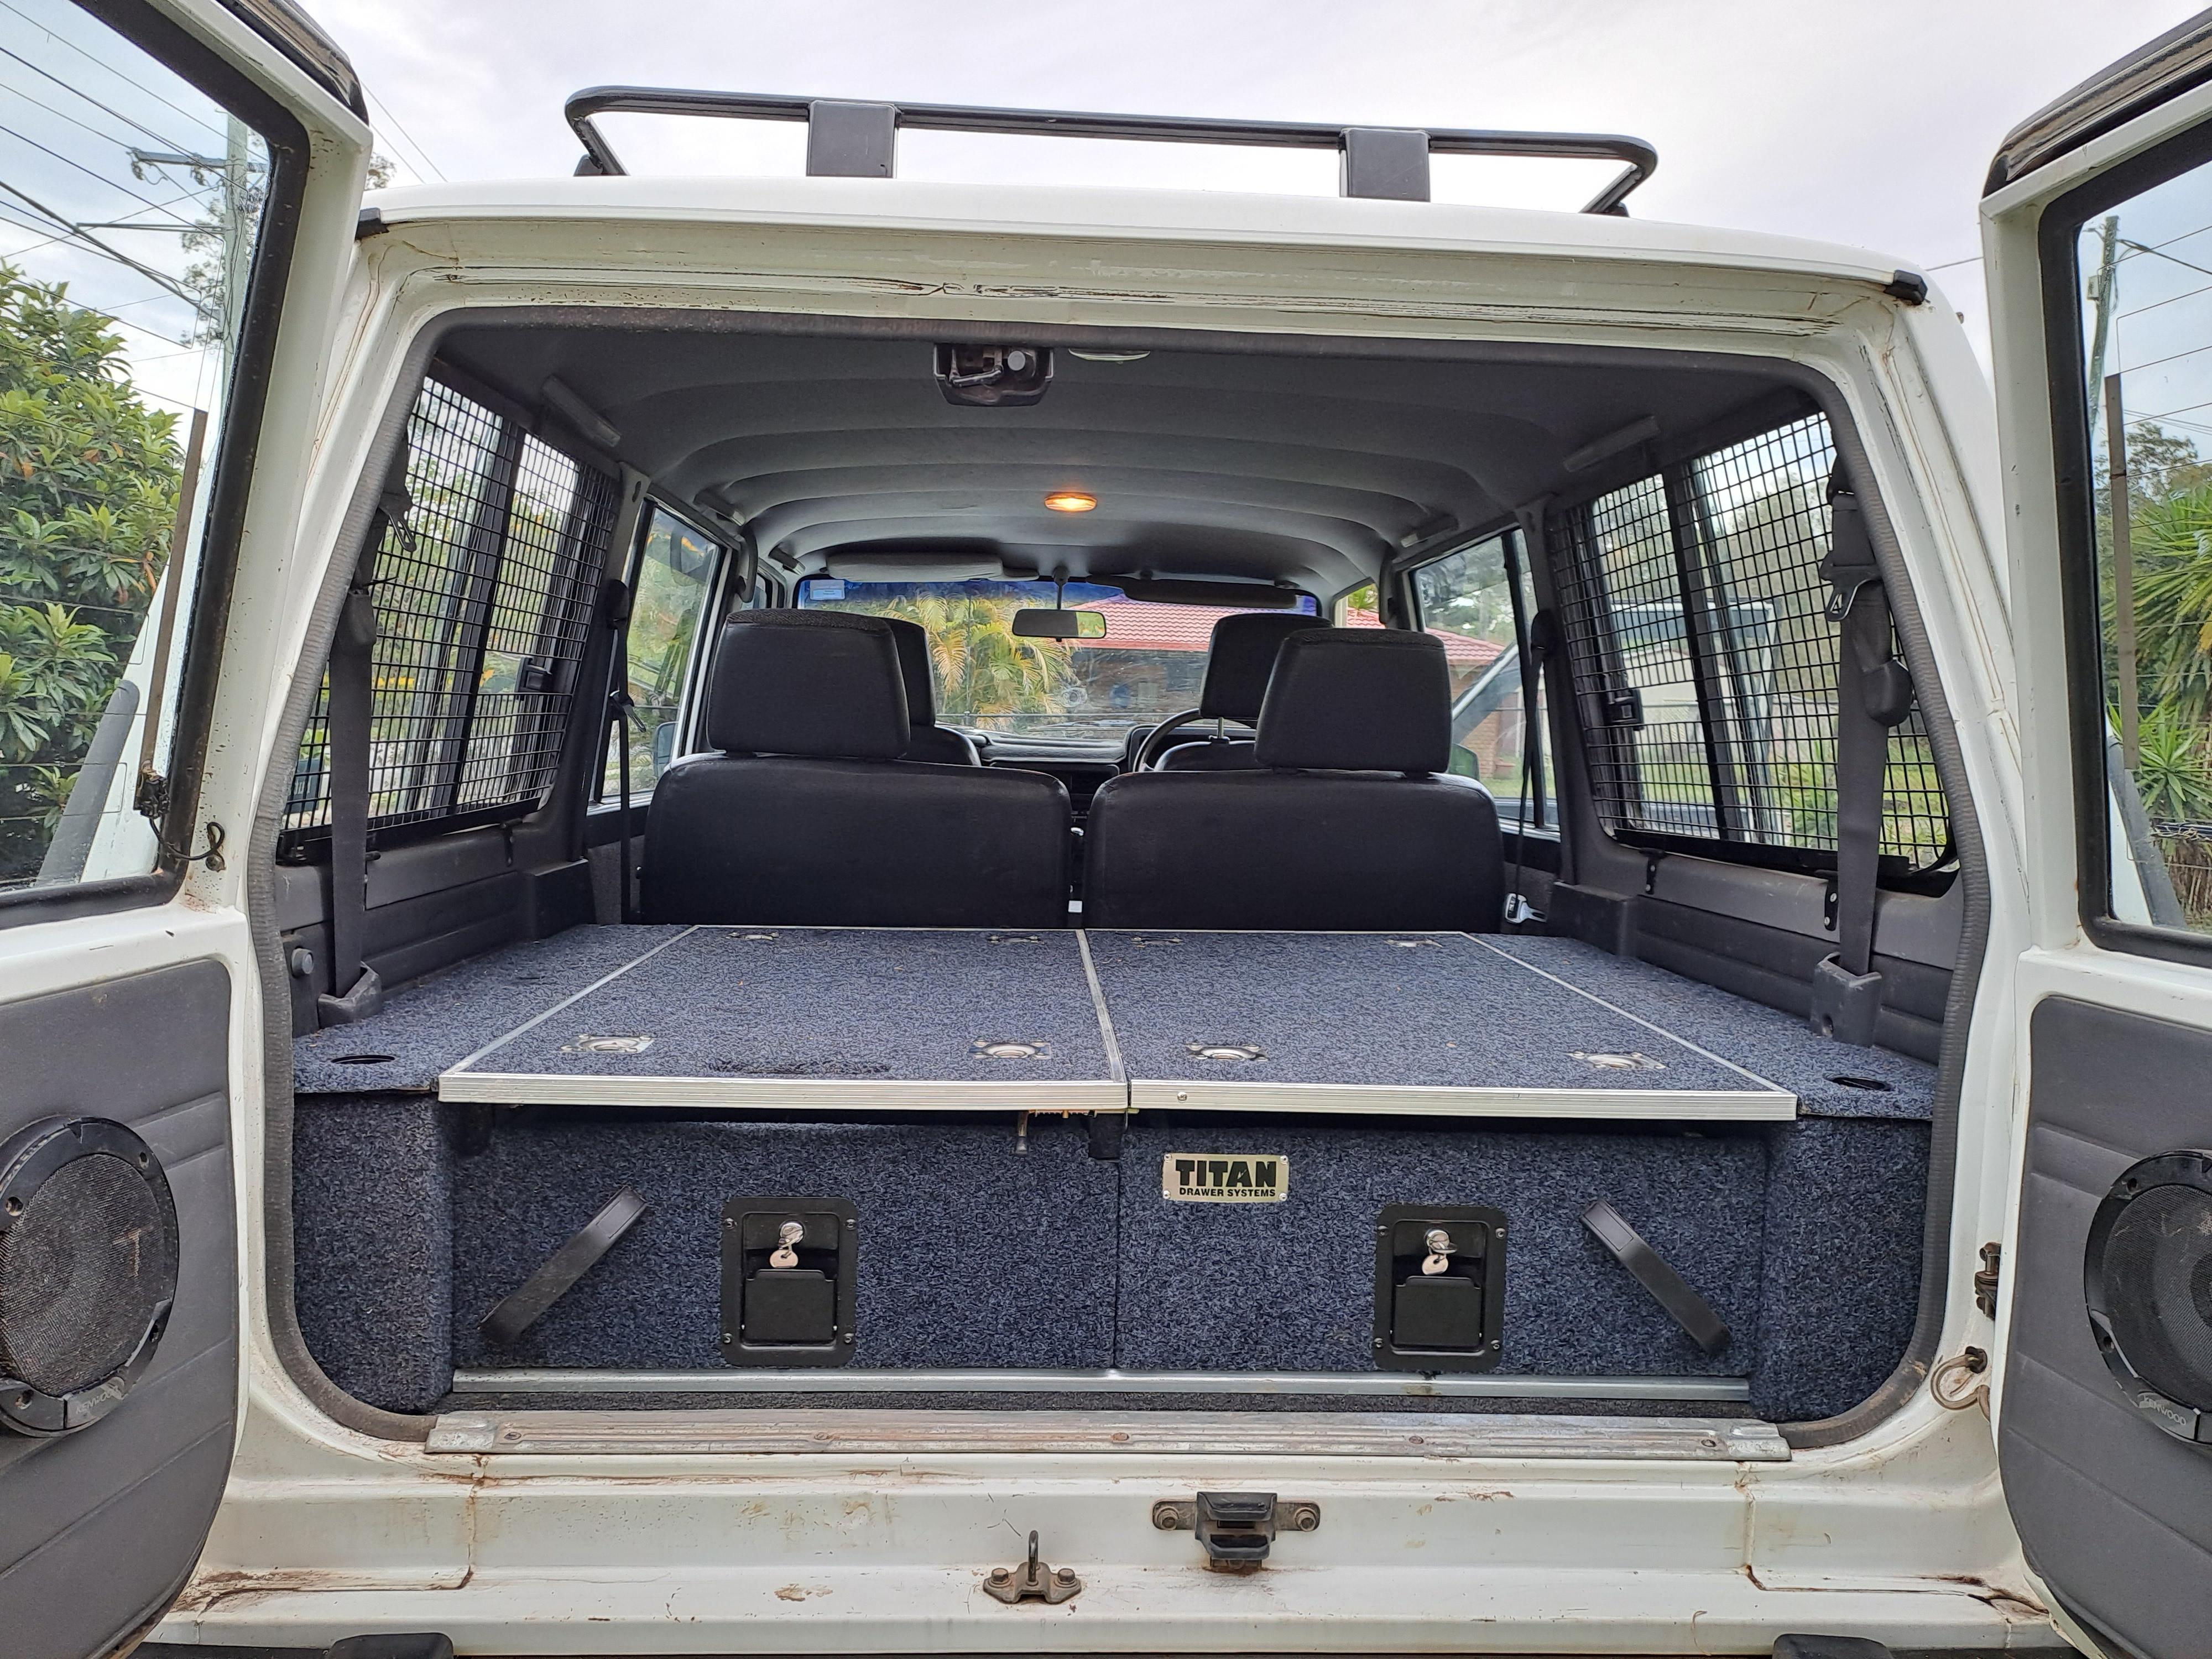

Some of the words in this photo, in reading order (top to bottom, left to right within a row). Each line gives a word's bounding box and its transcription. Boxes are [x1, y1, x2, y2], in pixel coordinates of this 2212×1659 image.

[1176, 1159, 1276, 1187] TITAN
[1179, 1187, 1224, 1197] DRAWER
[1227, 1189, 1276, 1197] SYSTEMS
